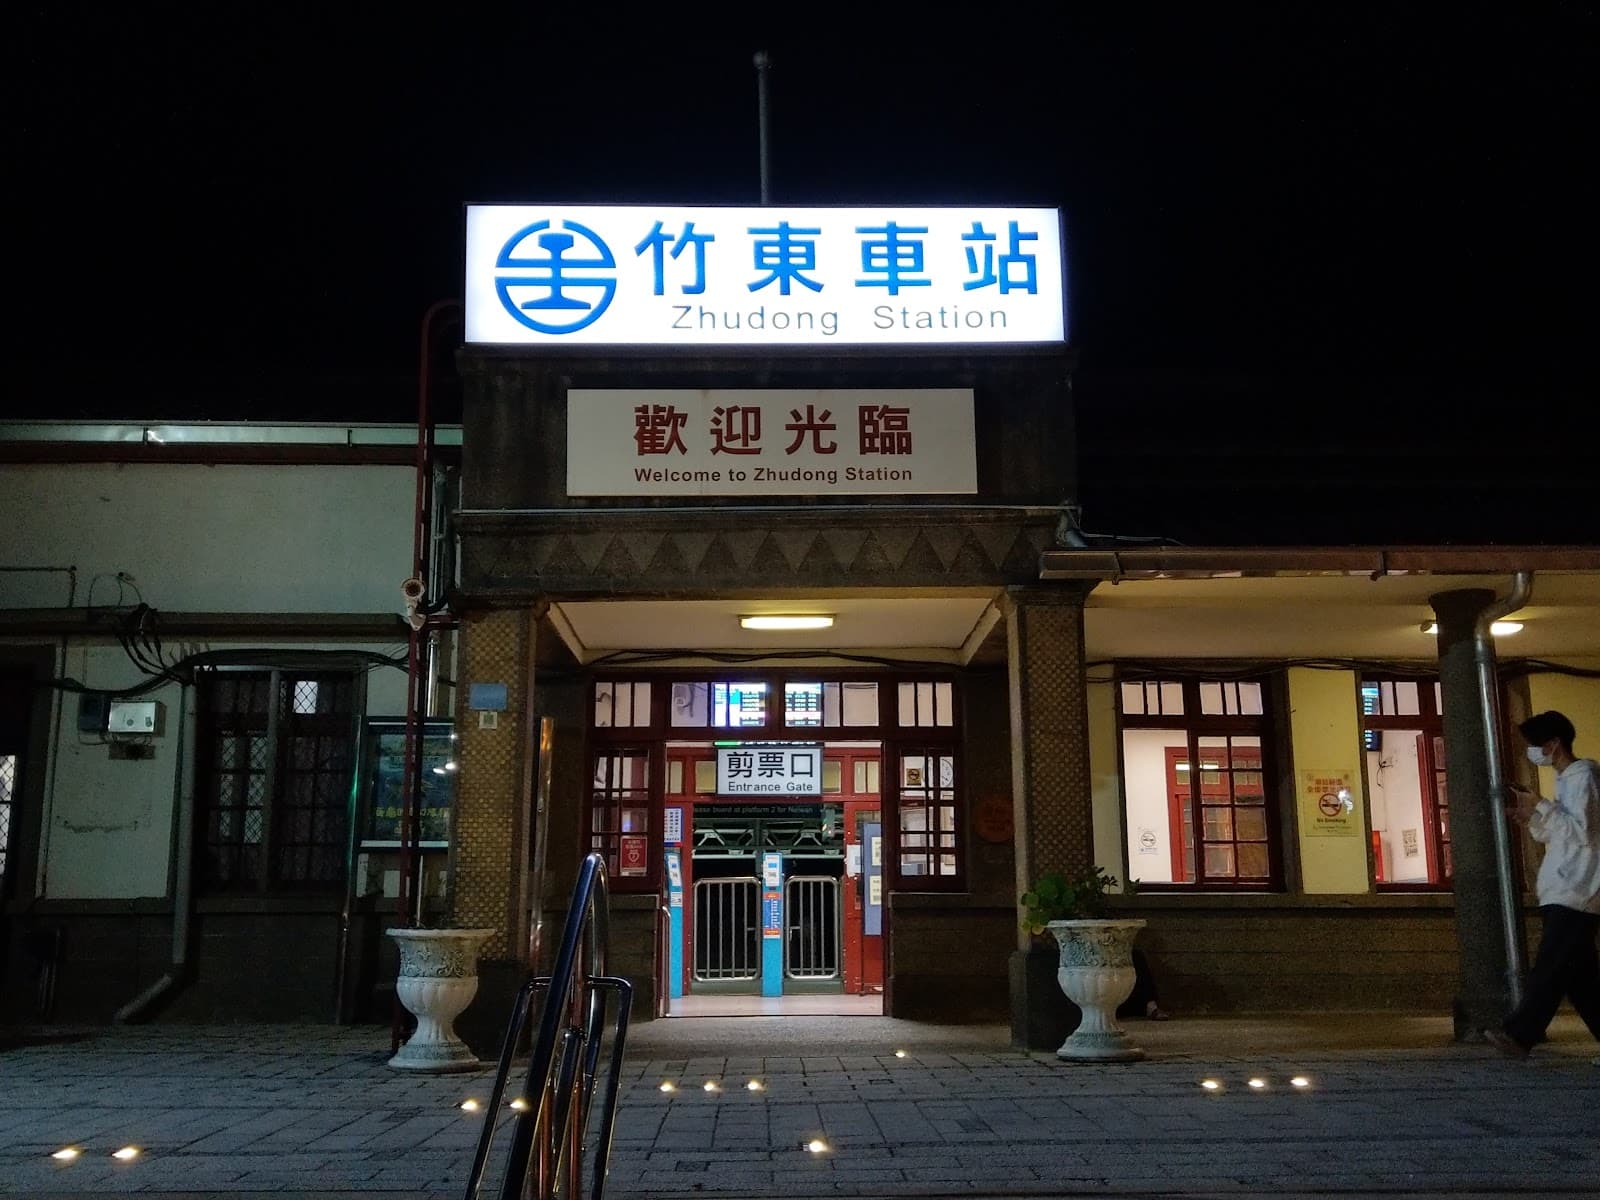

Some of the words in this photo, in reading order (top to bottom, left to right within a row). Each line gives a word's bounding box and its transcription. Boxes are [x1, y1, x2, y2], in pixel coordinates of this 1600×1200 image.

[634, 220, 1039, 296] 竹東車站
[672, 305, 838, 336] Zhudong
[874, 305, 1007, 330] Station
[634, 405, 912, 456] 歡迎光臨
[635, 468, 721, 482] Welcome
[729, 468, 747, 482] to
[754, 468, 838, 485] Zhudong
[846, 467, 912, 482] Station
[727, 751, 813, 778] 剪票口
[728, 781, 781, 792] Entrance
[786, 781, 813, 792] Gate
